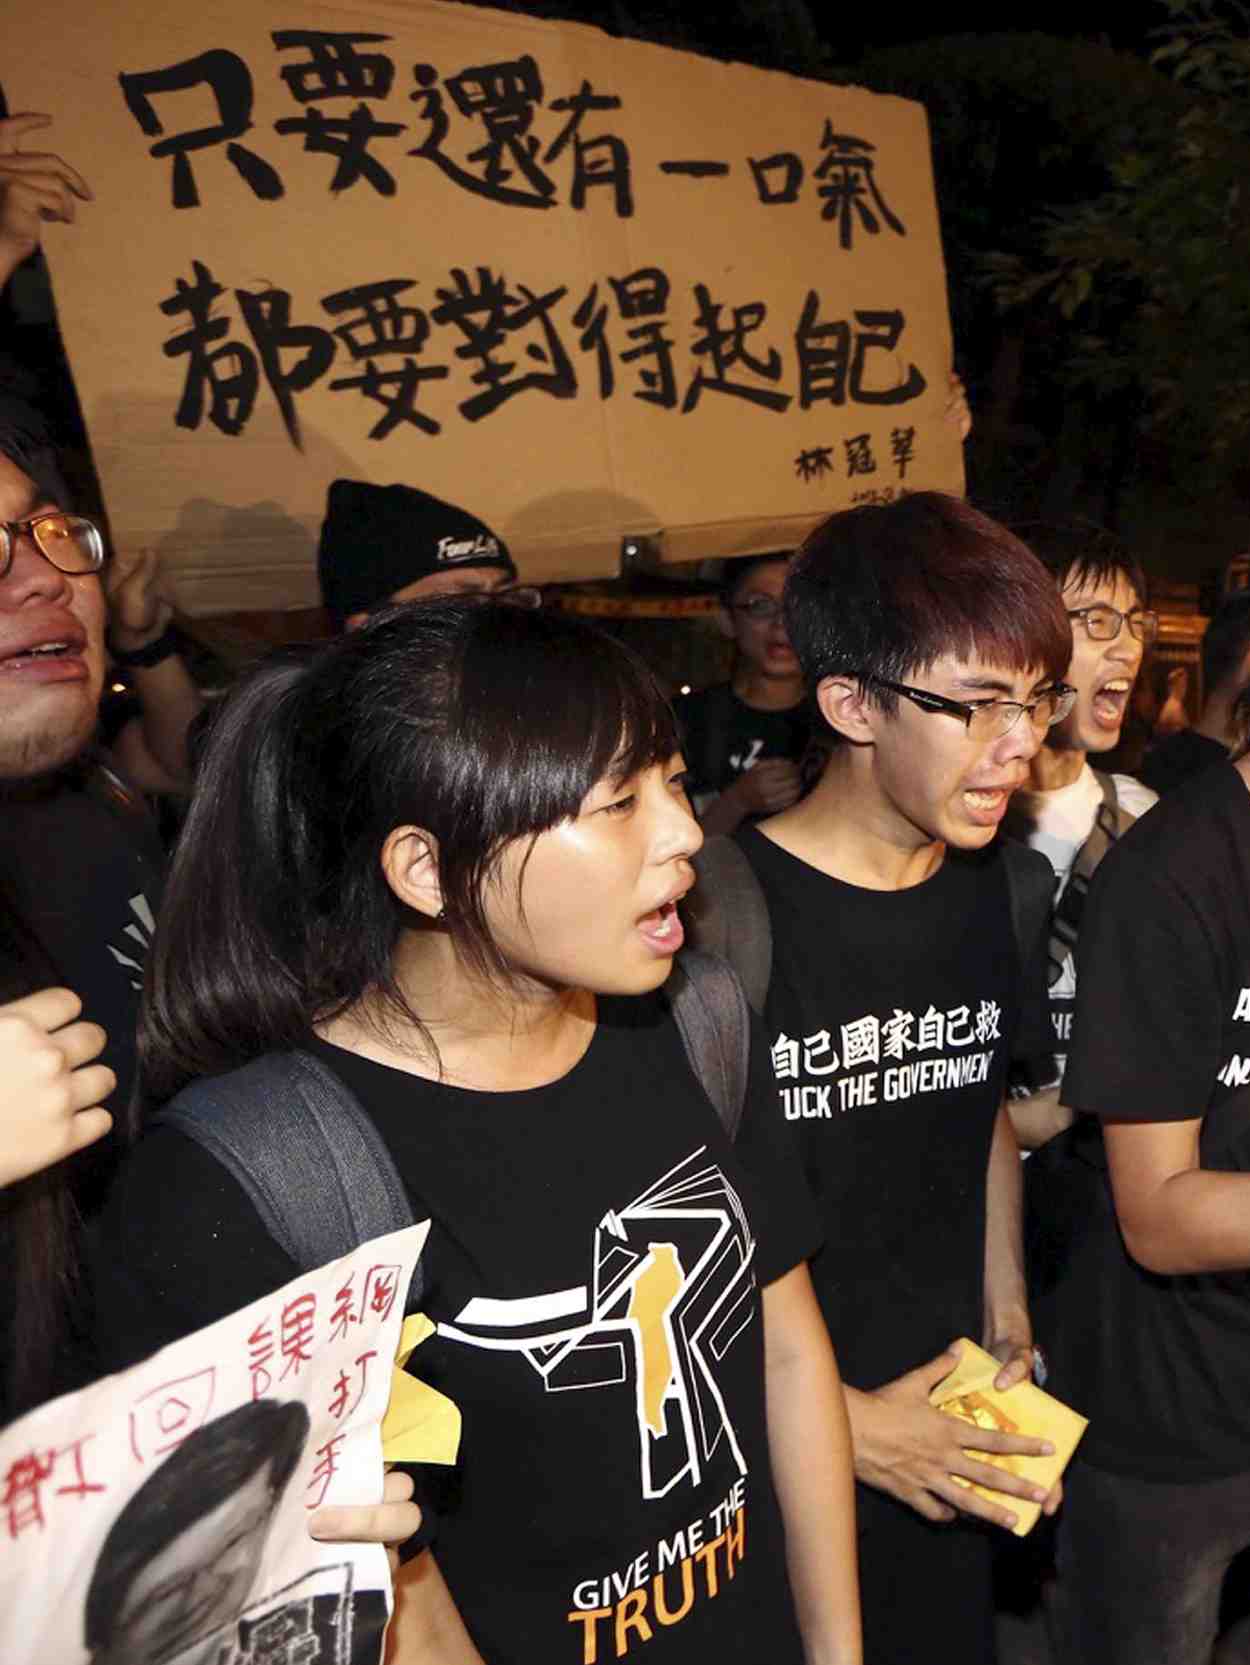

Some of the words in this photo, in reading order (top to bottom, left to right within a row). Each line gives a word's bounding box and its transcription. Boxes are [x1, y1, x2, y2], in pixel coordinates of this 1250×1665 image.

[118, 30, 906, 249] 只要還有一口氣
[158, 261, 926, 452] 都要對得起自己
[770, 998, 1001, 1080] 自己國家自己救
[779, 1085, 833, 1121] UCK
[837, 1070, 878, 1112] THE
[566, 1506, 747, 1665] TRUTH
[572, 1550, 650, 1611] GIVE
[656, 1519, 706, 1573] ME
[709, 1476, 747, 1538] THE
